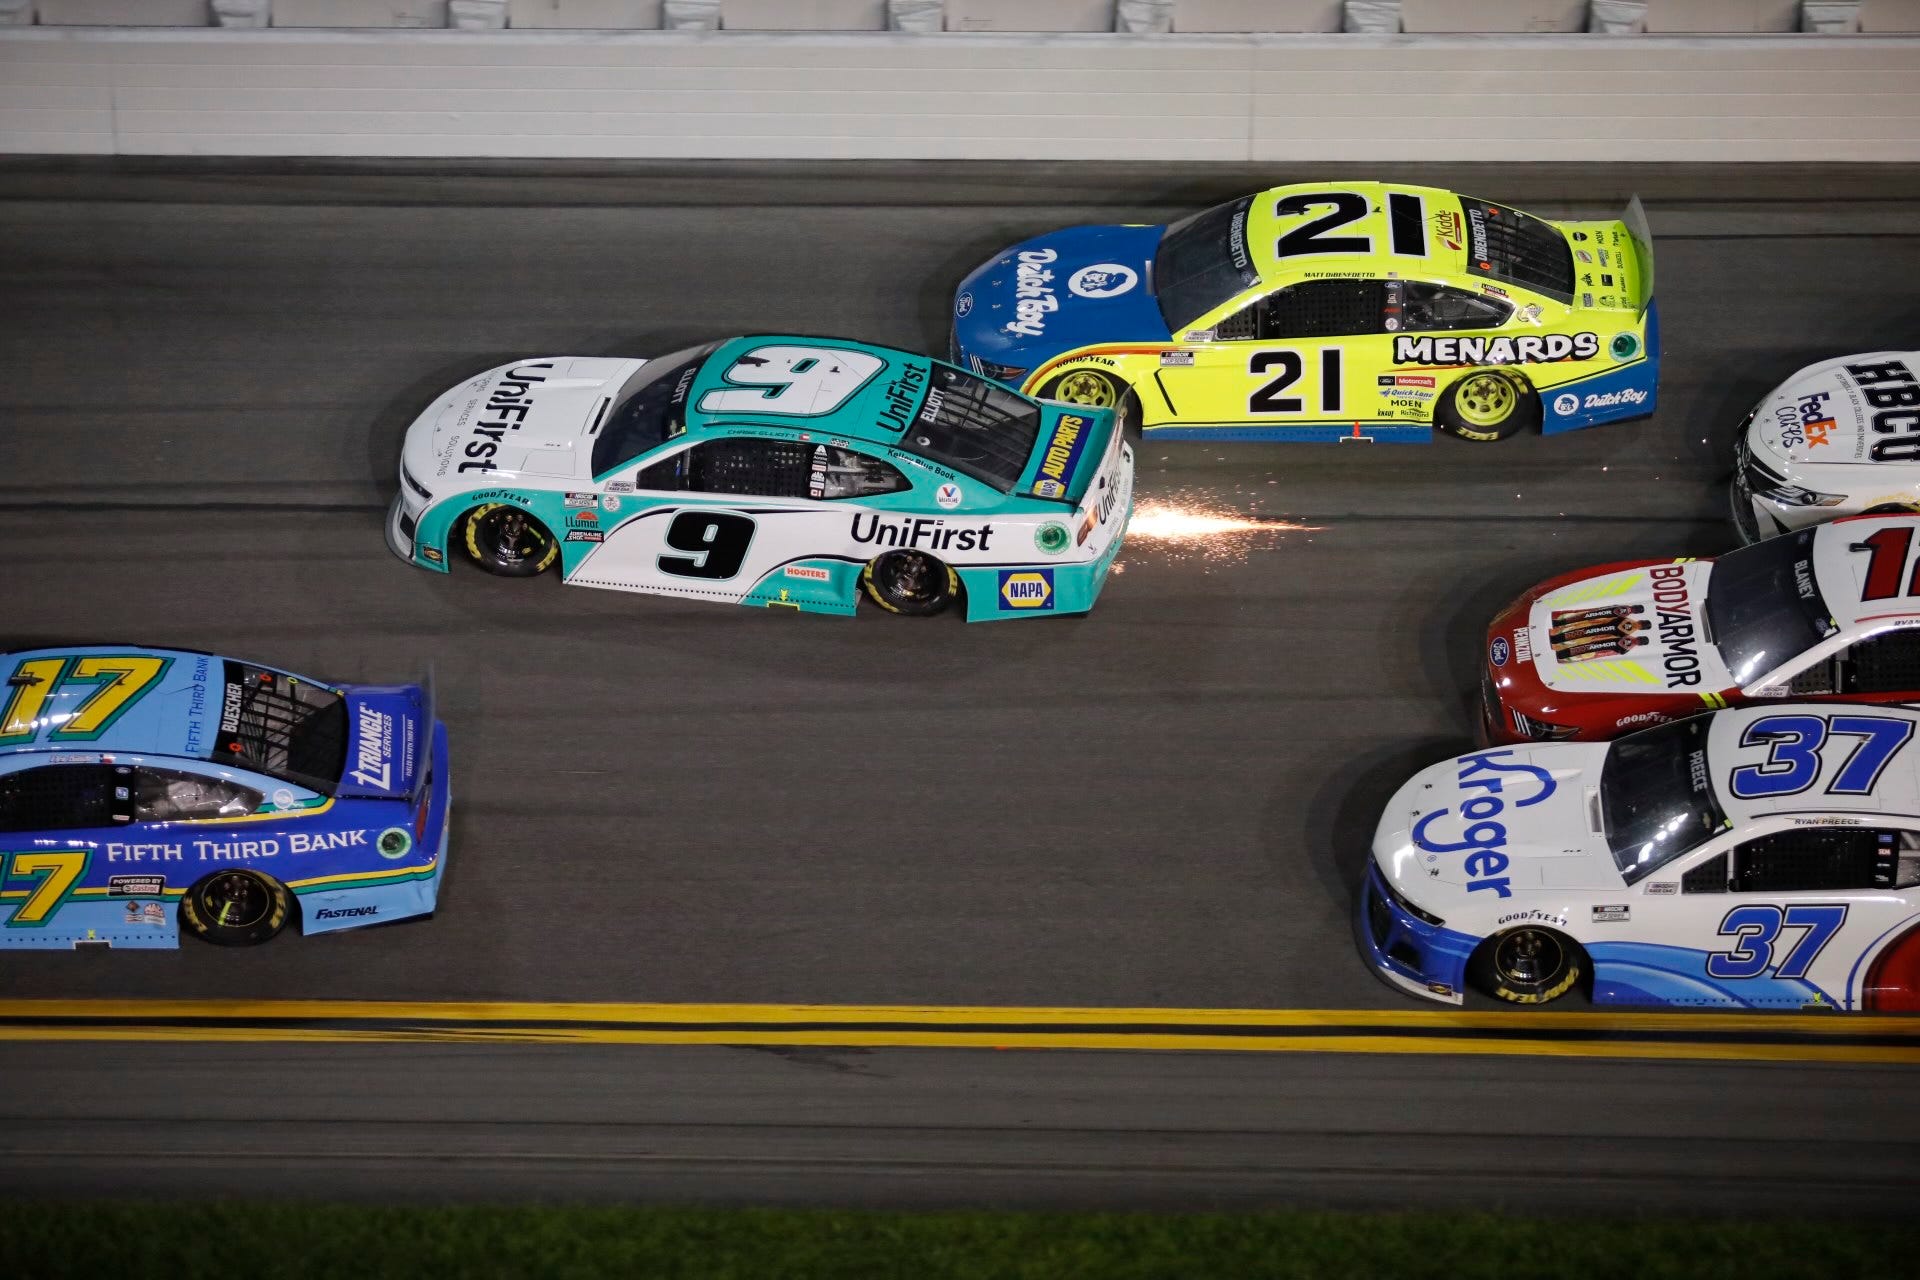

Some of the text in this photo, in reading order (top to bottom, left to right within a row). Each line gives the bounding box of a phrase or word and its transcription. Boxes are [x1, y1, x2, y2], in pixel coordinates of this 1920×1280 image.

[1230, 211, 1247, 269] DIBENEDETTO
[1275, 192, 1427, 258] 21
[1436, 209, 1452, 238] Kidde
[1468, 208, 1488, 262] DIBENEDETTO
[1006, 248, 1059, 336] Dutch Boy
[1393, 331, 1600, 365] MENARDS
[670, 367, 697, 404] ELLIOTT
[875, 361, 928, 434] UniFirst
[1249, 349, 1341, 413] 21
[1398, 378, 1433, 386] Motorcraft
[1415, 390, 1434, 398] Lane
[1584, 388, 1648, 409] Dutch Boy
[457, 363, 554, 474] UniFirst
[920, 385, 946, 423] ELLIOTT
[1391, 400, 1422, 409] MOEN
[1400, 409, 1430, 418] Richmond
[1797, 391, 1838, 449] FedEx
[887, 448, 956, 482] Kelley Blue Book
[1041, 414, 1084, 480] AUTO PARTS
[472, 489, 530, 506] GOODYEAR
[656, 508, 758, 582] 9
[851, 512, 994, 551] UniFirst
[786, 567, 827, 580] HOOTERS
[1794, 559, 1816, 599] BLANEY
[1859, 527, 1920, 602] 1
[1009, 582, 1045, 598] NAPA
[1512, 626, 1532, 664] PENNZOIL
[1649, 565, 1702, 689] BODYARMOR
[0, 654, 176, 747] 17
[185, 656, 209, 753] FIFTH THIRD BANK
[221, 682, 243, 733] BUESCHER
[1615, 711, 1673, 728] GOODYEA
[358, 704, 383, 774] TRIANGLE
[382, 714, 393, 759] SERVICES
[1728, 714, 1918, 801] 37
[1688, 750, 1708, 792] PREECE
[1411, 750, 1558, 899] Kroger
[1794, 818, 1861, 826] RYAN PREECE
[107, 829, 369, 863] FIFTH THIRD BANK
[0, 849, 93, 928] 7
[315, 904, 380, 920] FASTENAL
[1705, 903, 1850, 980] 37
